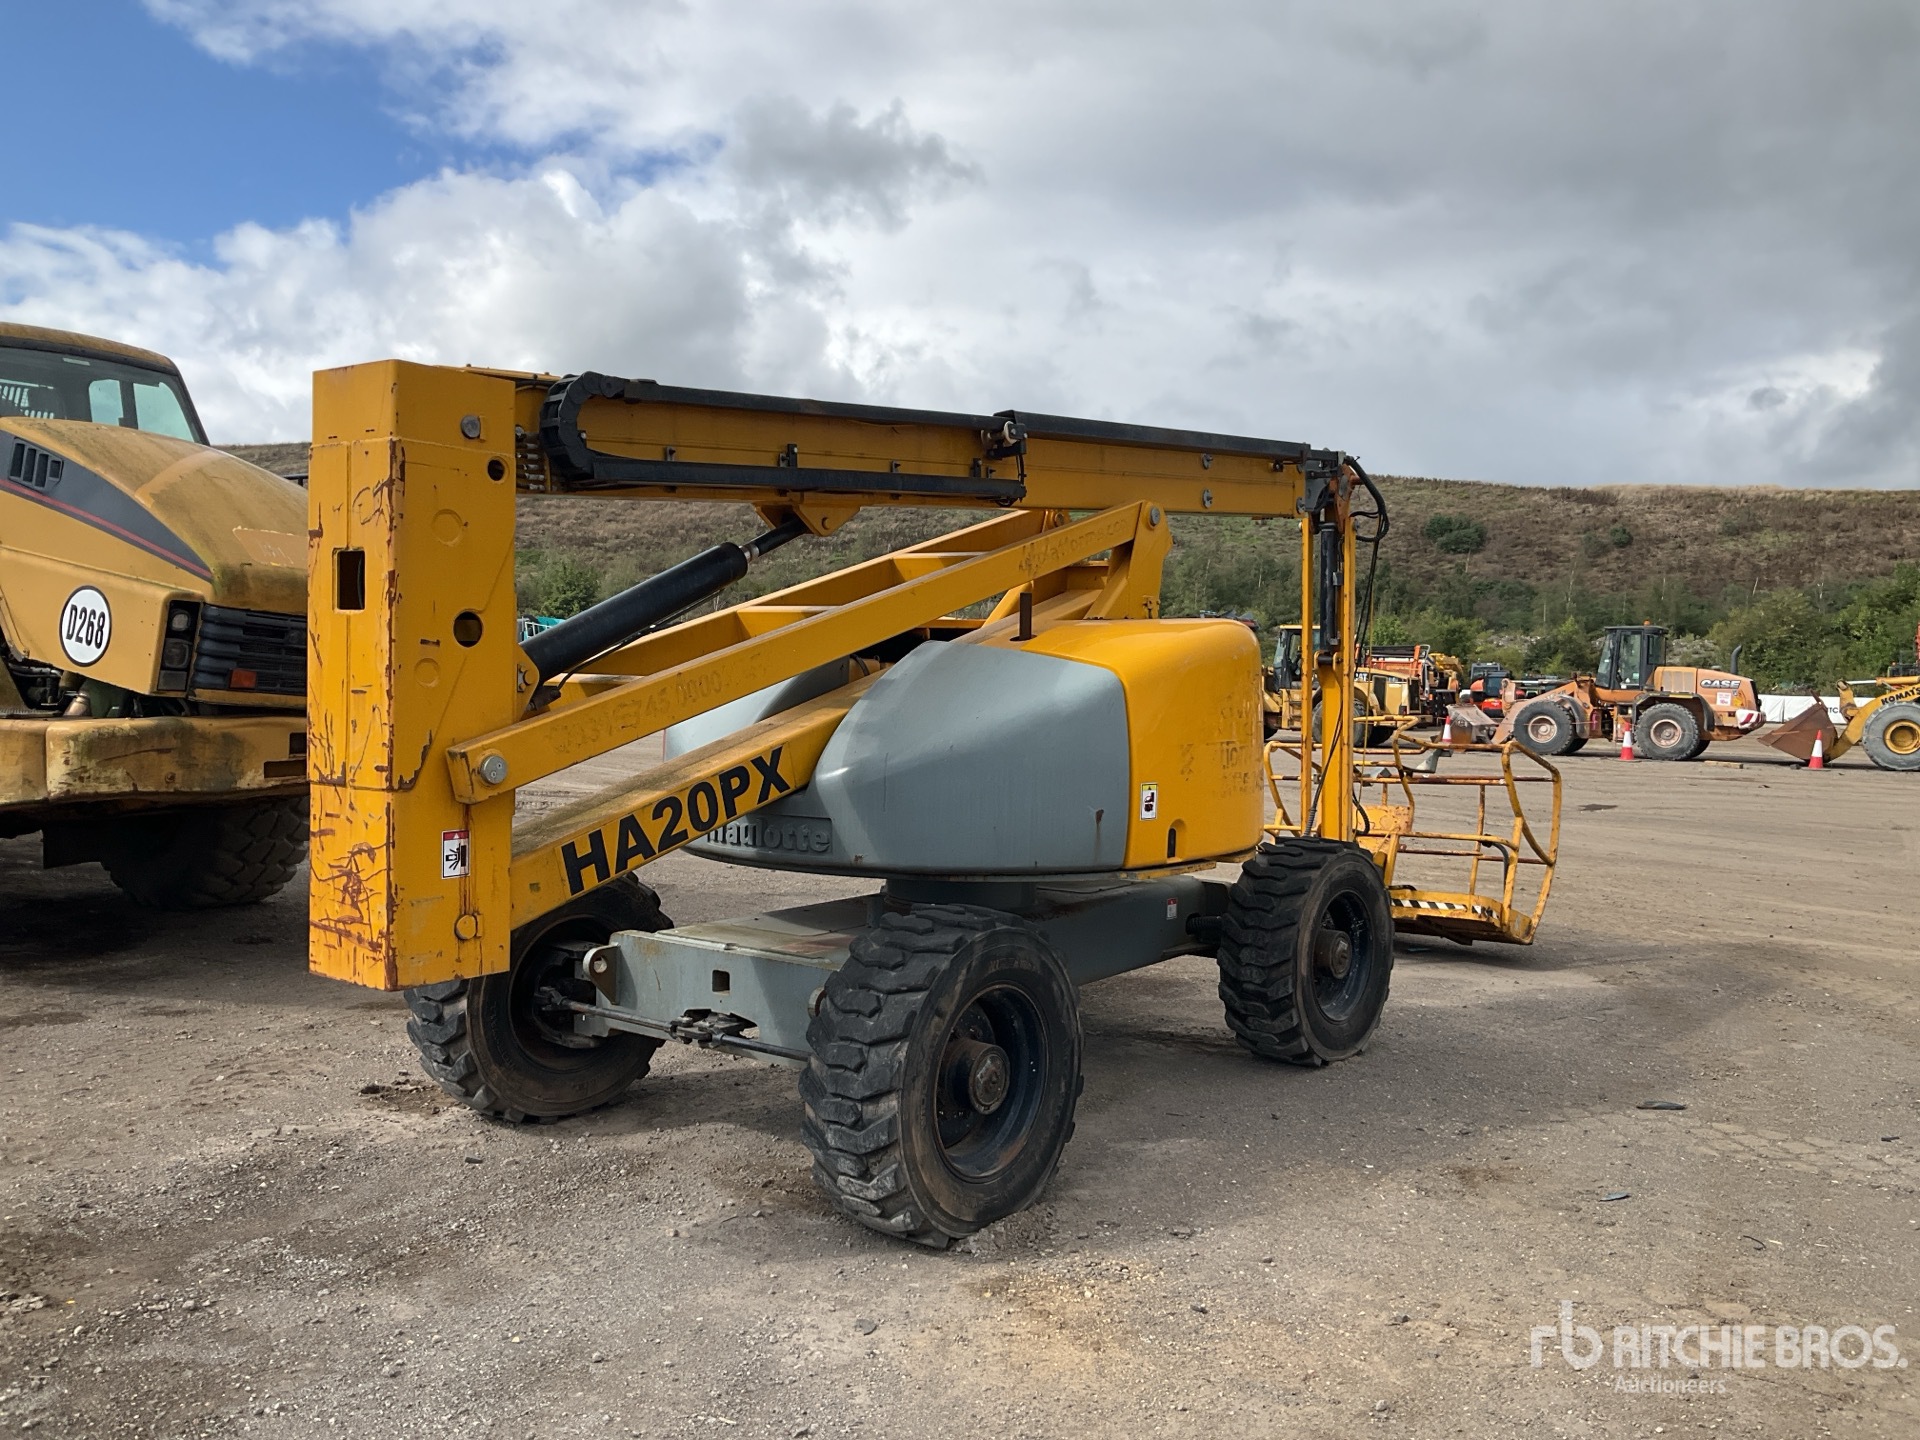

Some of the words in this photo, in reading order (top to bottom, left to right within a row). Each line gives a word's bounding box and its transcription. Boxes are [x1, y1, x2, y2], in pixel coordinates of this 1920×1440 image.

[66, 604, 106, 649] D268
[1700, 679, 1741, 689] CASE
[561, 746, 790, 896] HA20PX
